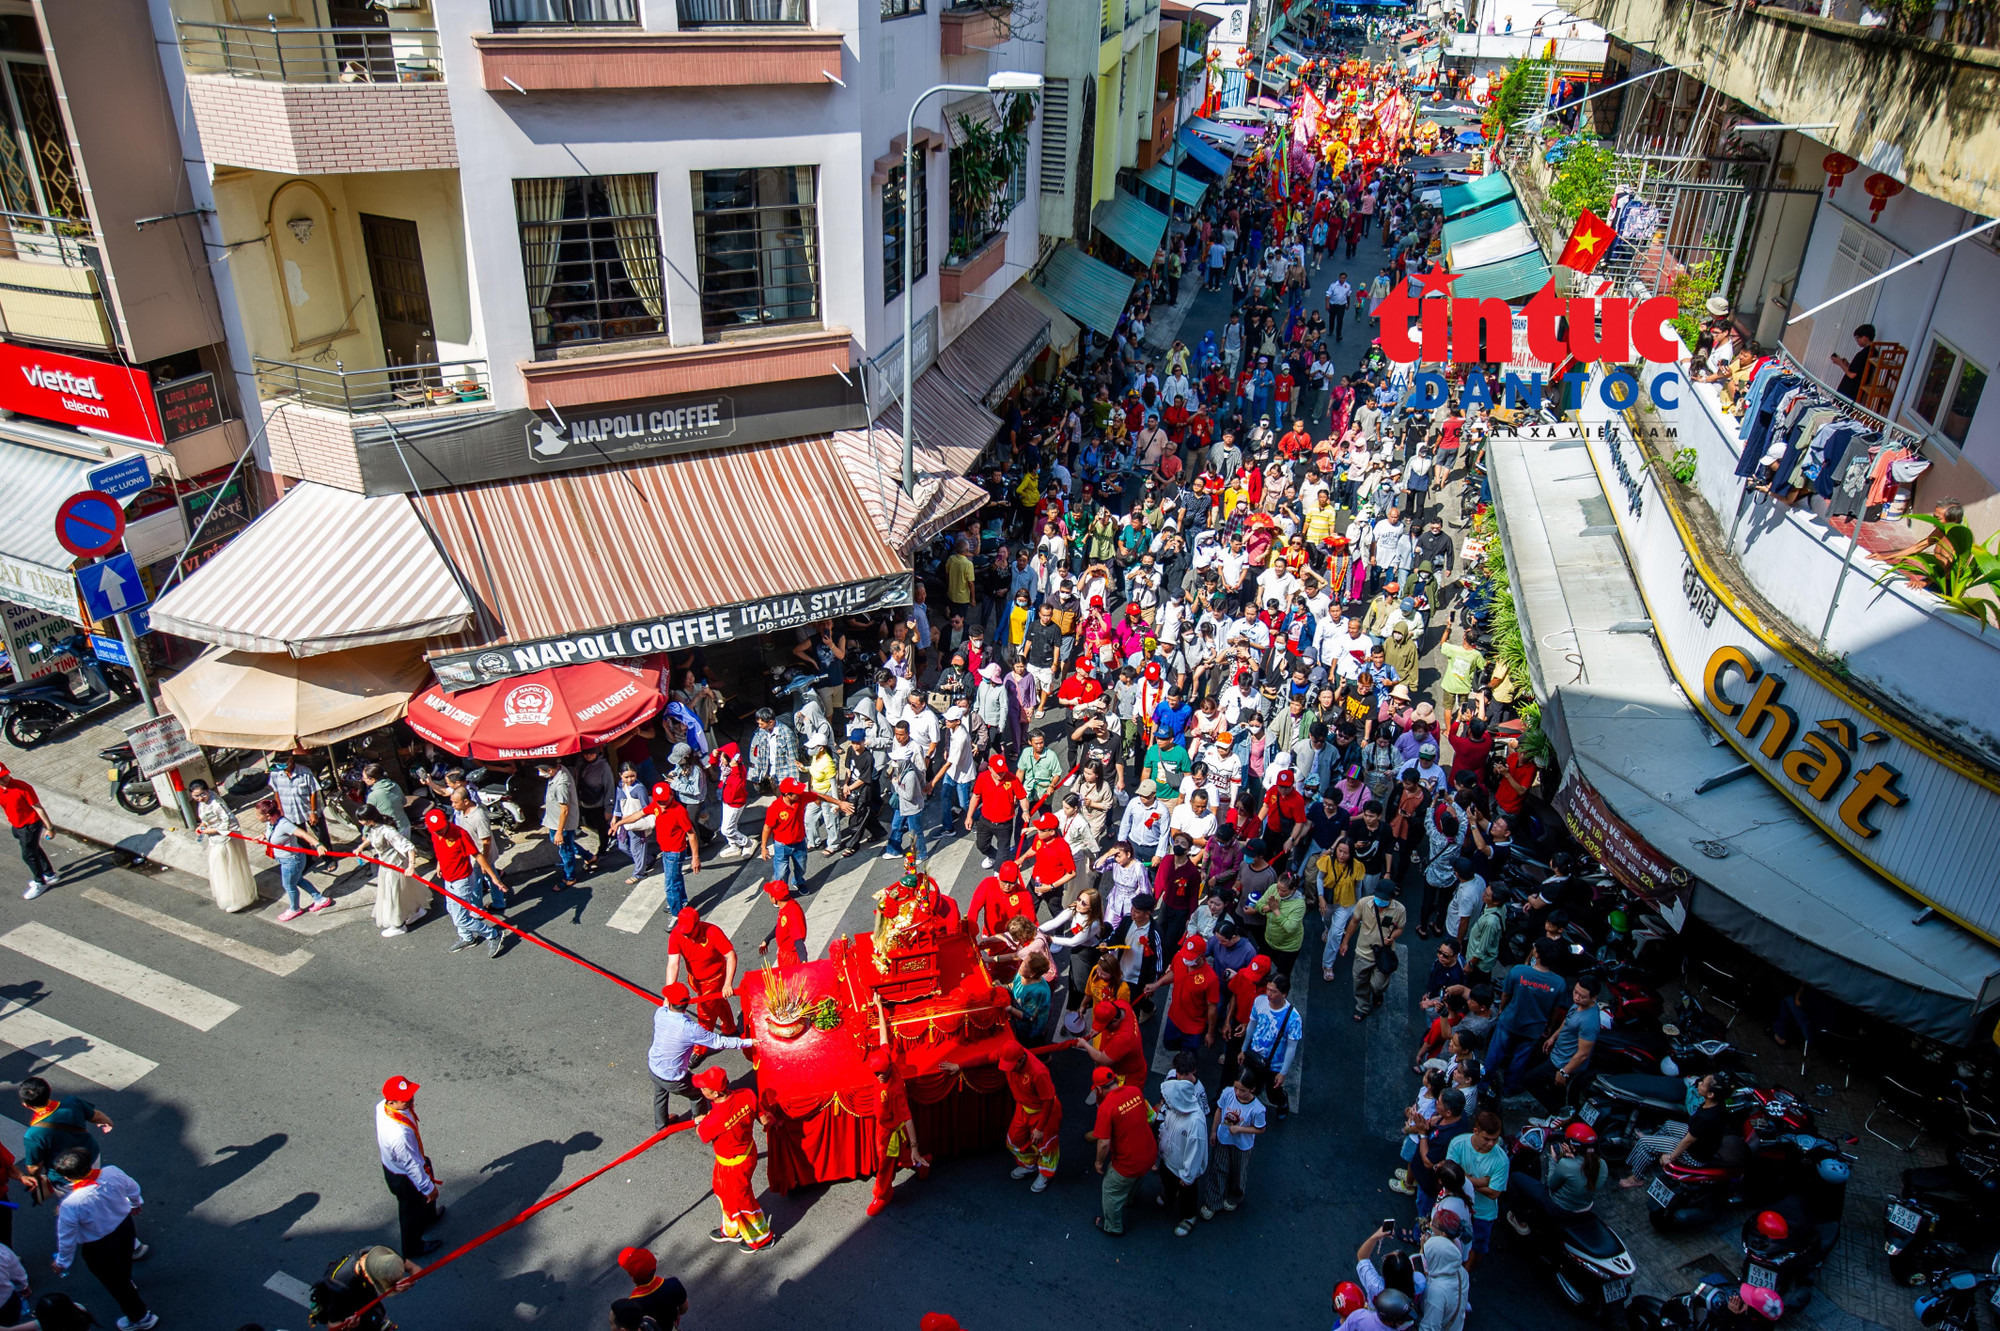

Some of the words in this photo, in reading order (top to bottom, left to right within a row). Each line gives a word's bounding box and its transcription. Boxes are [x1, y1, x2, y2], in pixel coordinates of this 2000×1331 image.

[21, 365, 104, 400] viettel
[62, 396, 110, 419] telecom
[571, 413, 645, 445] NAPOLI
[650, 403, 721, 434] COFFEE
[644, 435, 671, 443] ITALIA
[684, 429, 708, 438] STYLE
[119, 475, 145, 490] LƯƠNG
[13, 614, 38, 632] MUA
[513, 631, 626, 672] NAPOLI
[630, 612, 734, 652] COFFEE
[740, 598, 805, 625] ITALIA
[811, 586, 866, 611] STYLE
[54, 656, 79, 674] TÍNH
[519, 686, 543, 694] NAPOLI
[576, 701, 609, 722] NAPOLI
[604, 682, 638, 708] COFFEE
[424, 693, 456, 717] NAPOLI
[451, 708, 475, 727] COFFEE
[498, 748, 528, 758] NAPOLI
[529, 744, 558, 755] COFFEE
[1703, 644, 1911, 839] Chất
[1566, 812, 1584, 840] GIẢM
[1584, 836, 1602, 859] 20%
[1589, 805, 1608, 831] Mang
[1624, 838, 1642, 861] Phin
[1648, 861, 1668, 884] Máy
